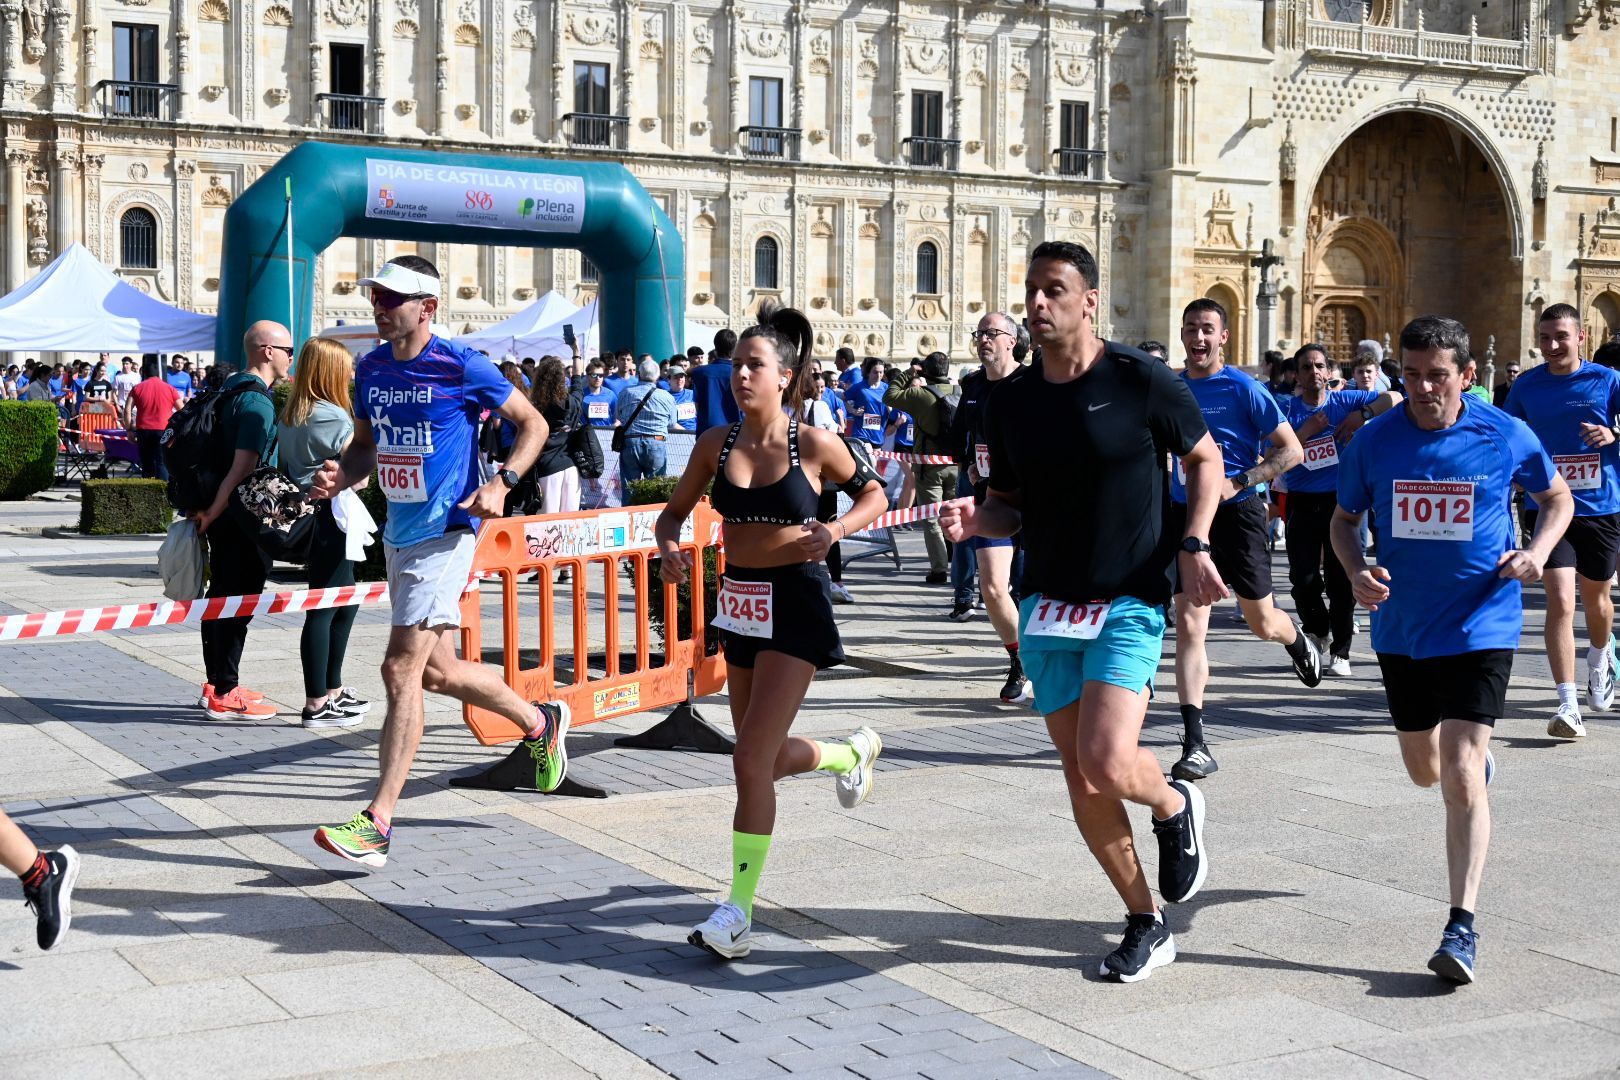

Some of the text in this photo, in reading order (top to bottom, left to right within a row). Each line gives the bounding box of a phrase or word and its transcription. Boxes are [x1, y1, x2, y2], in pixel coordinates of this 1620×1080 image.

[375, 162, 579, 193] DÍA DE CASTILLA Y LEÓN
[373, 207, 400, 216] Castilla
[408, 210, 428, 219] León
[394, 202, 417, 210] Junta
[536, 198, 575, 214] Plena
[535, 213, 574, 222] inclusión
[368, 386, 432, 407] Pajariel
[379, 466, 420, 490] 1061
[747, 516, 792, 524] ARMOUR
[1397, 496, 1471, 524] 1012
[719, 593, 770, 622] 1245
[1038, 601, 1103, 626] 1101
